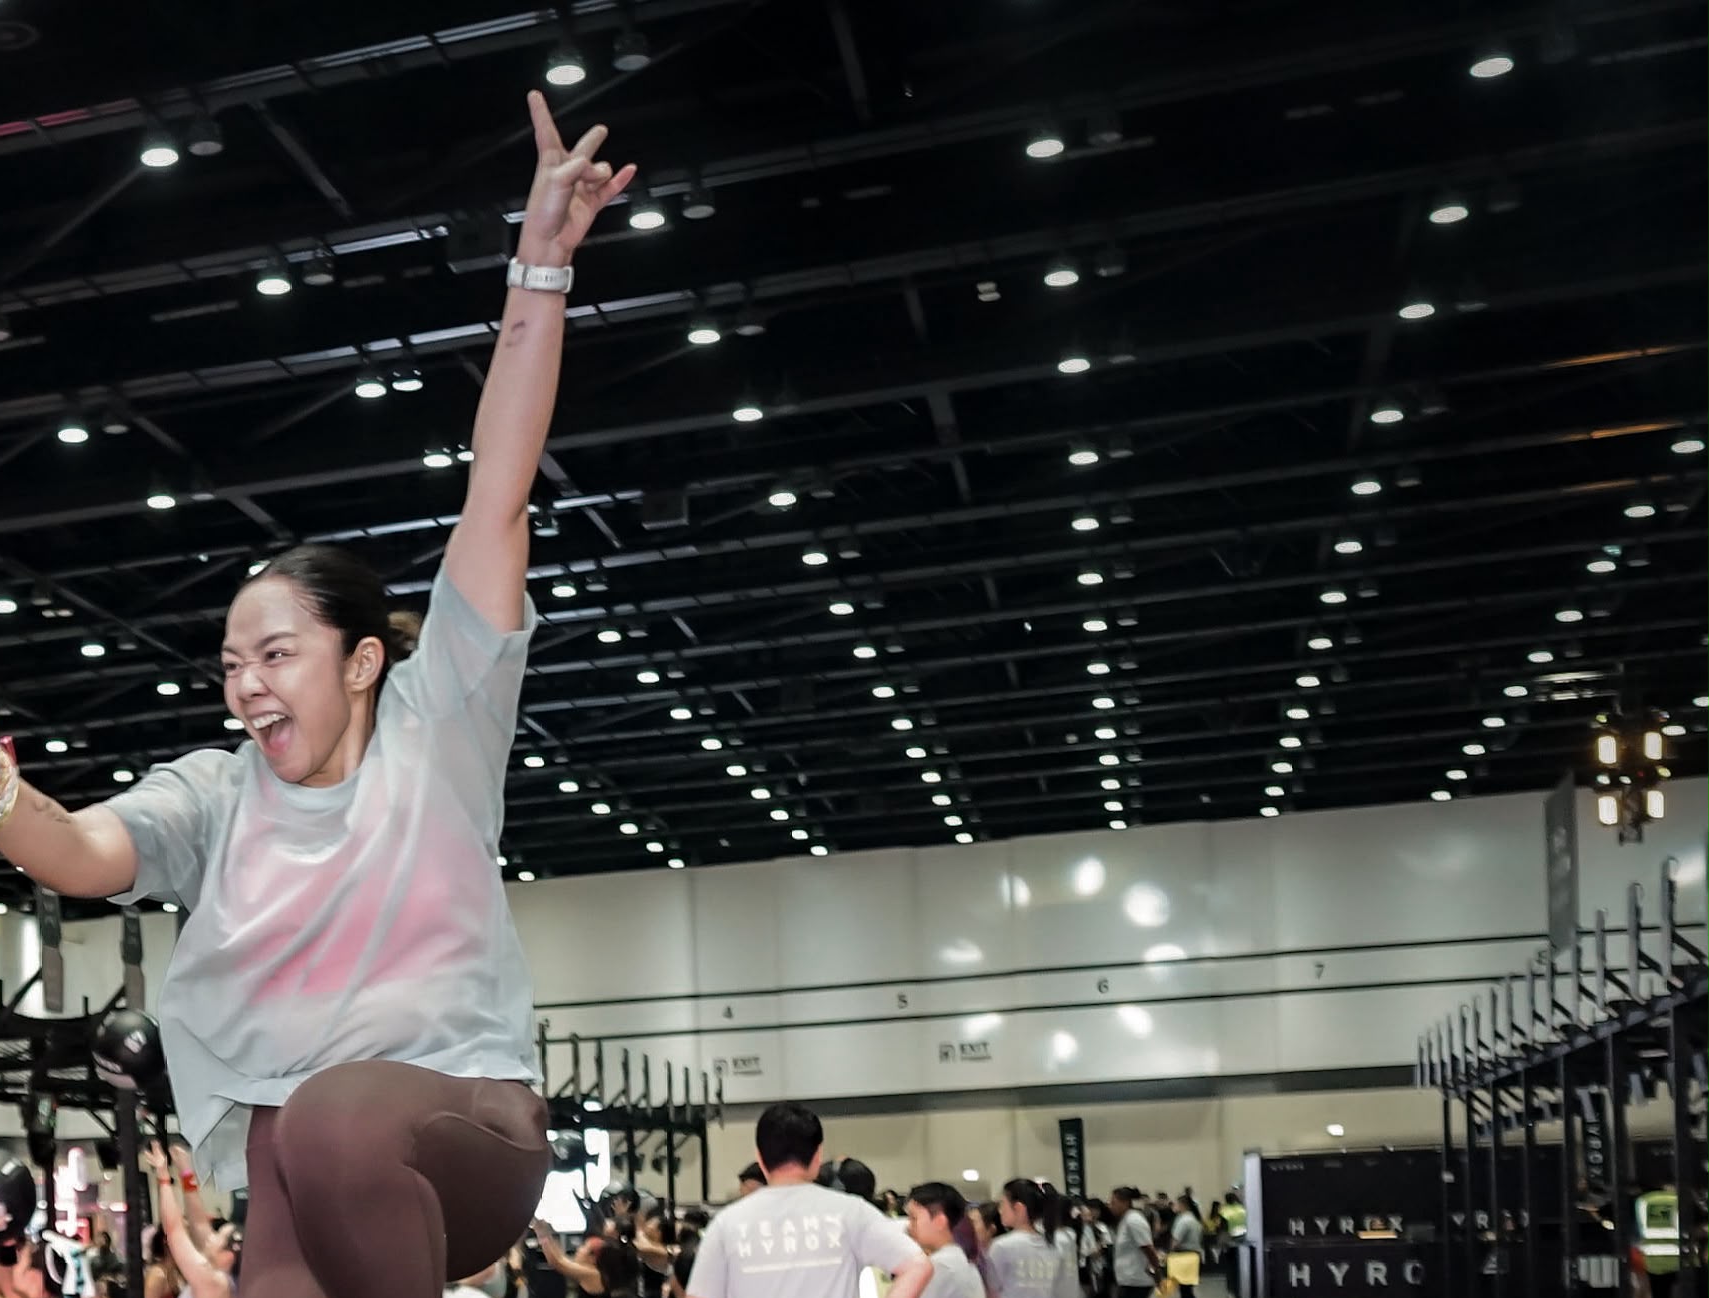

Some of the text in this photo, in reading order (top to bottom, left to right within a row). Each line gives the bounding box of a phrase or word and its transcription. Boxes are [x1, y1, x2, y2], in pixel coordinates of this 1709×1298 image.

[1313, 962, 1325, 980] 7
[1097, 978, 1110, 995] 6
[722, 1005, 734, 1020] 4
[959, 1041, 990, 1056] EXIT
[732, 1056, 761, 1069] EXIT
[737, 1231, 842, 1257] HYROX
